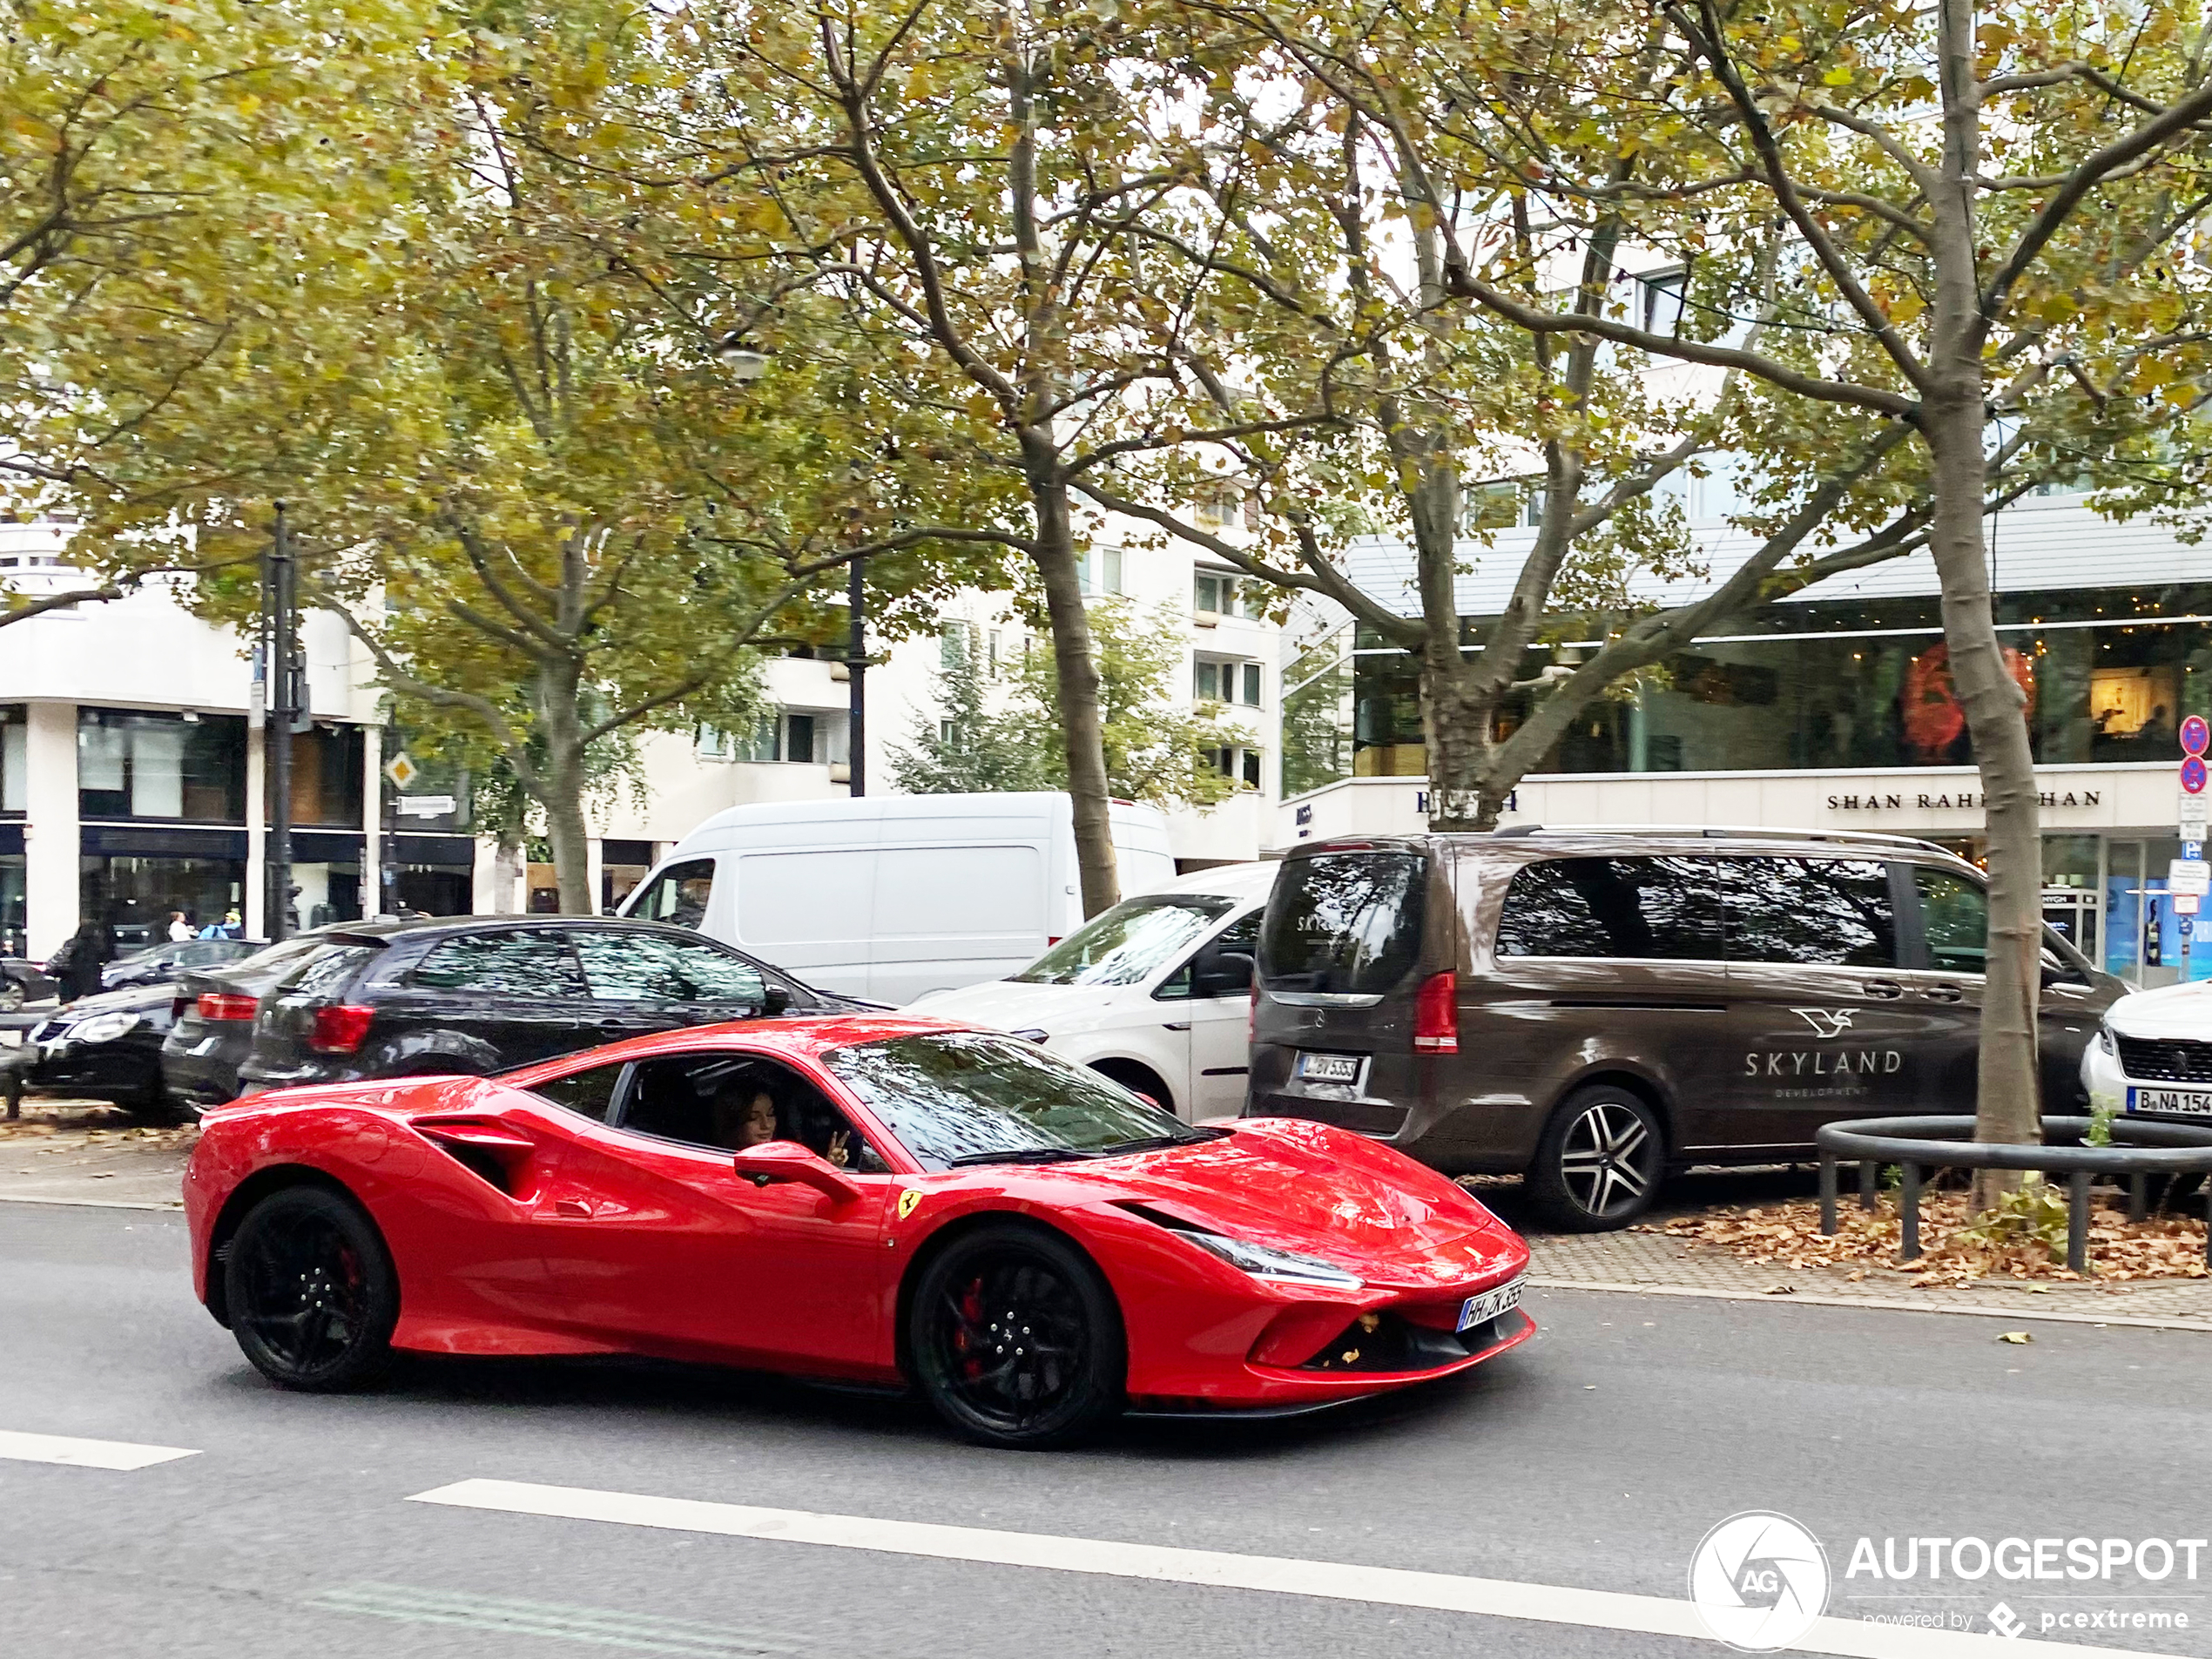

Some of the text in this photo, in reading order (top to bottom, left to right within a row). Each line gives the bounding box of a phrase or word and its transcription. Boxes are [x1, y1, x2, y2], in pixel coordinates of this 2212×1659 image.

[1827, 794, 1902, 810] SHAN
[1745, 1050, 1902, 1076] SKYLAND
[2141, 1091, 2211, 1113] B NA 154
[1466, 1298, 1487, 1325] HH
